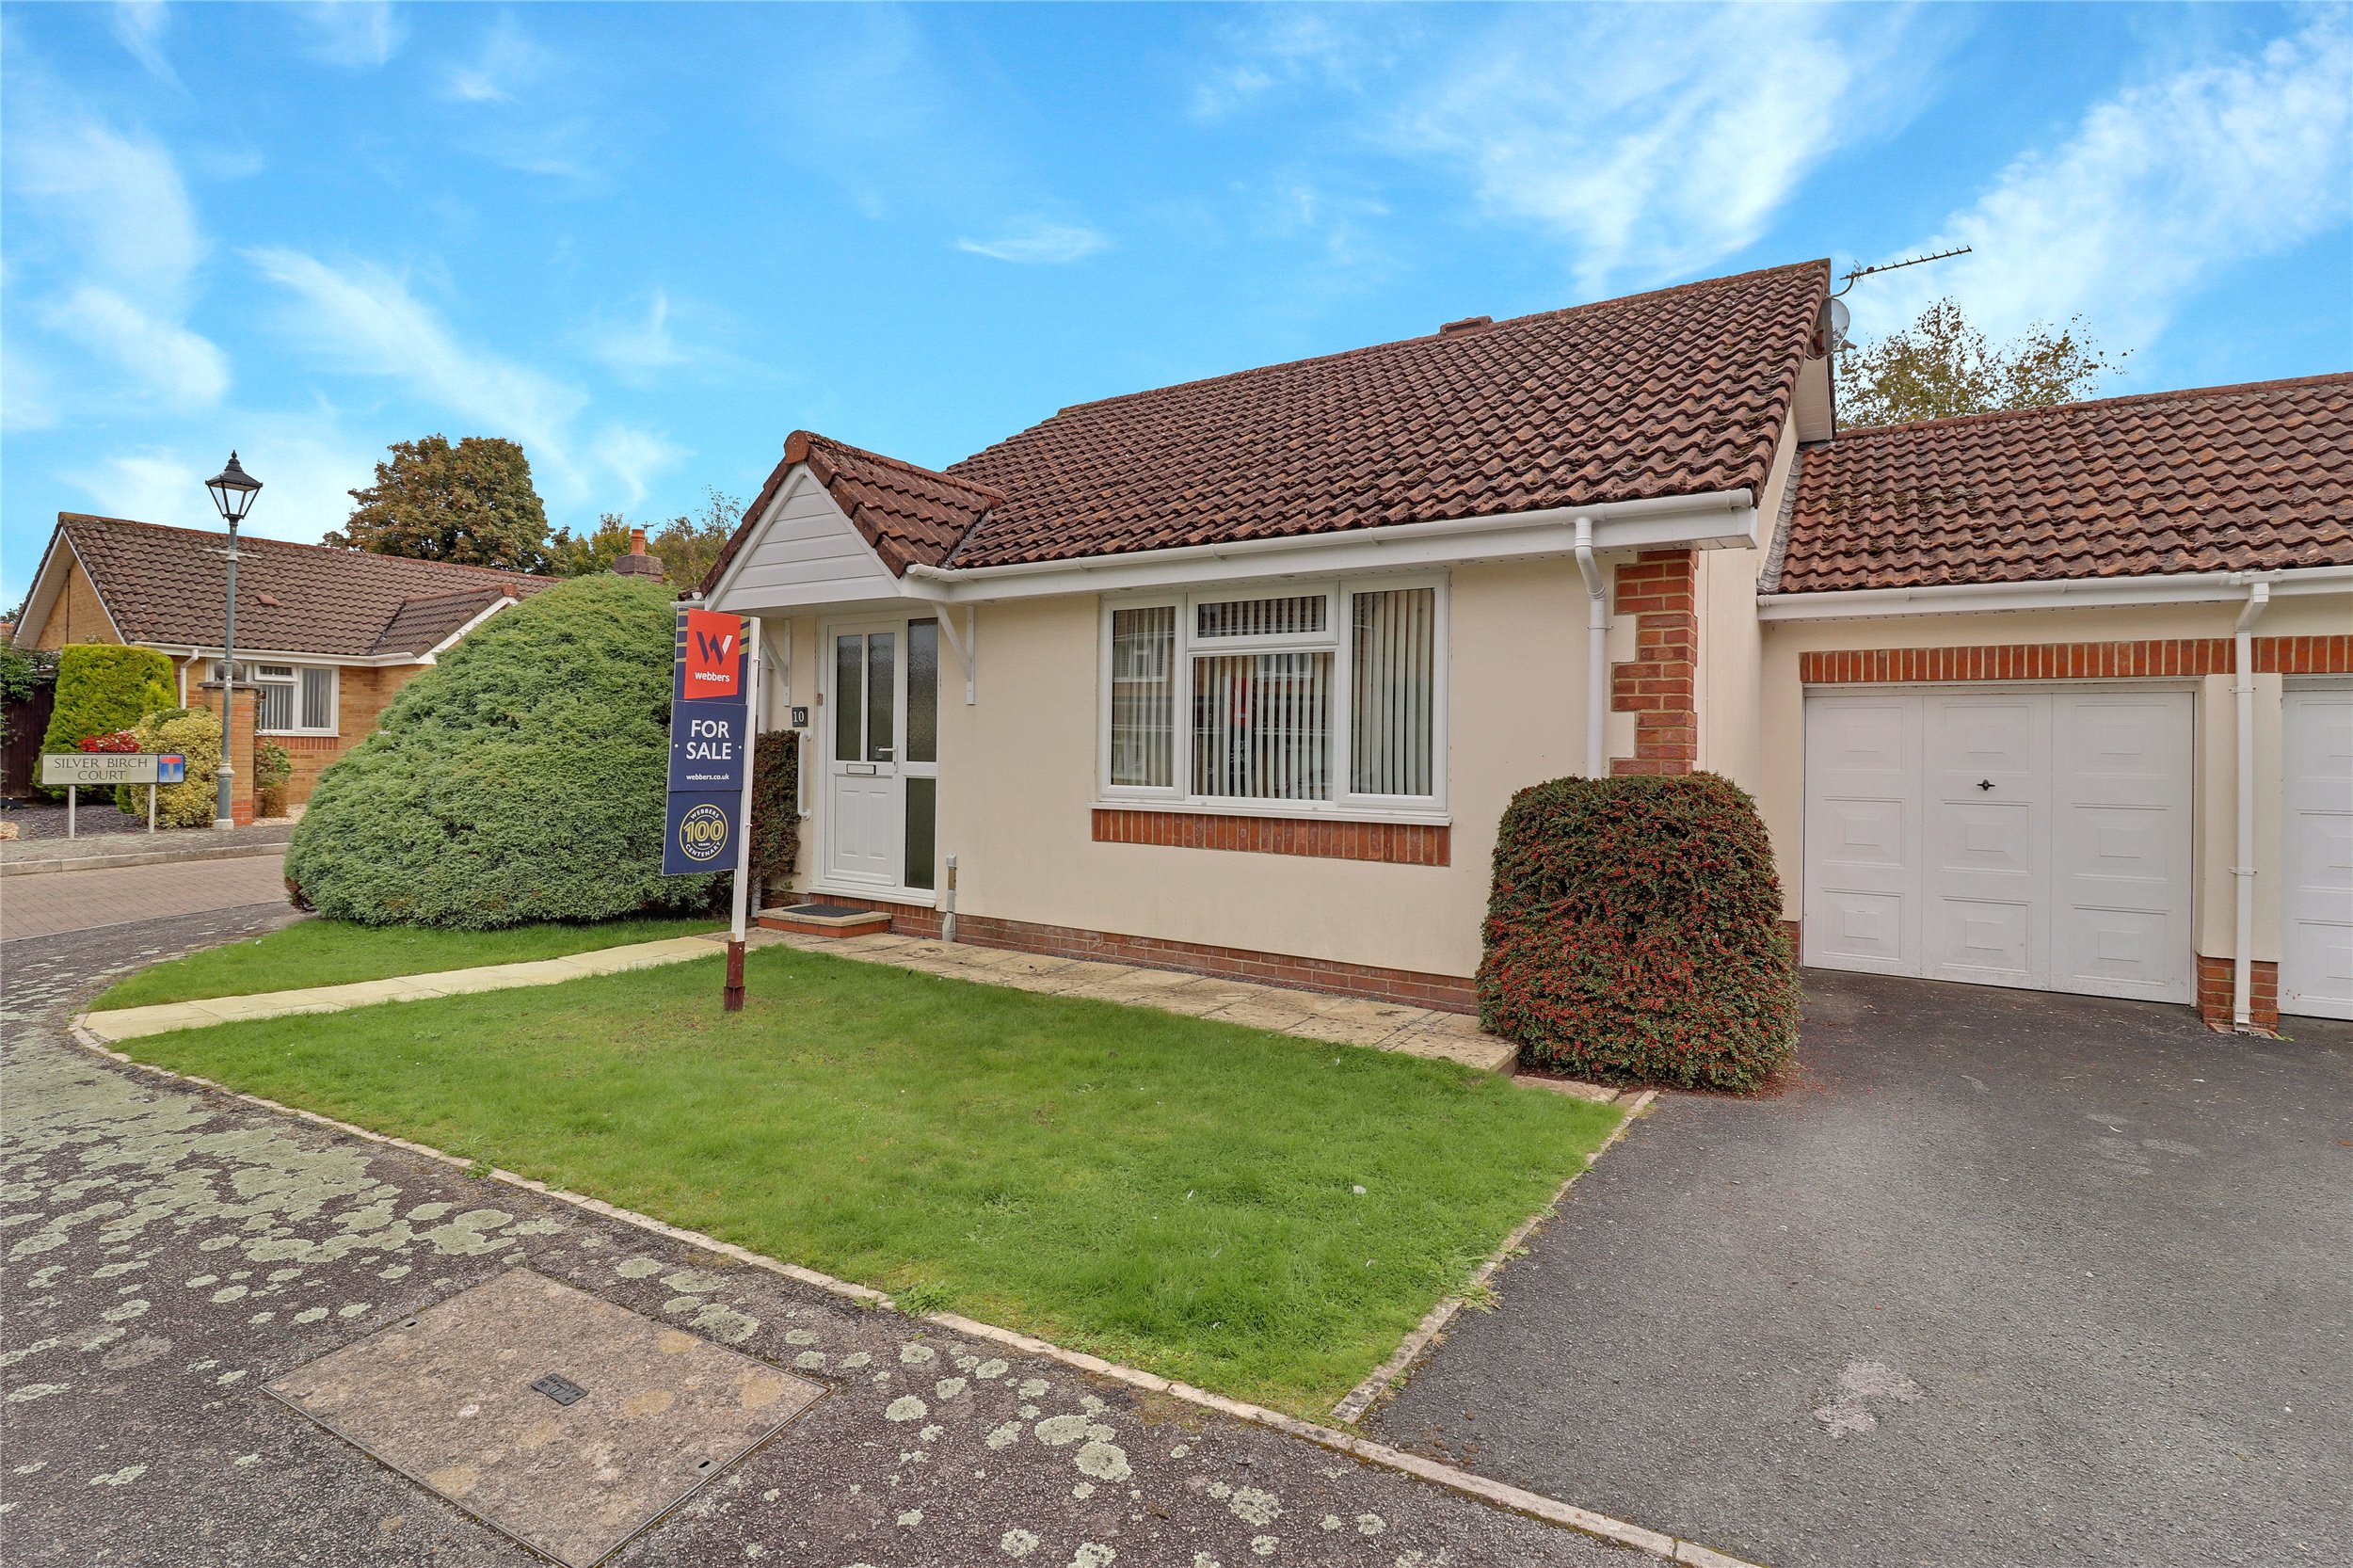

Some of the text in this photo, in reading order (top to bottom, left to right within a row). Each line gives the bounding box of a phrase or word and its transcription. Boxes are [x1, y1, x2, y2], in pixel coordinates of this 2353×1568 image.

[695, 671, 730, 682] webbers
[792, 711, 805, 723] 10
[691, 719, 730, 739] FOR
[686, 742, 732, 760] SALE
[54, 758, 148, 769] SILVER BIRCH
[77, 770, 126, 780] COURT
[685, 773, 730, 781] webbers.co.uk
[690, 808, 720, 819] WEBBERS
[683, 820, 725, 842] 100
[685, 841, 721, 857] CENTENARY
